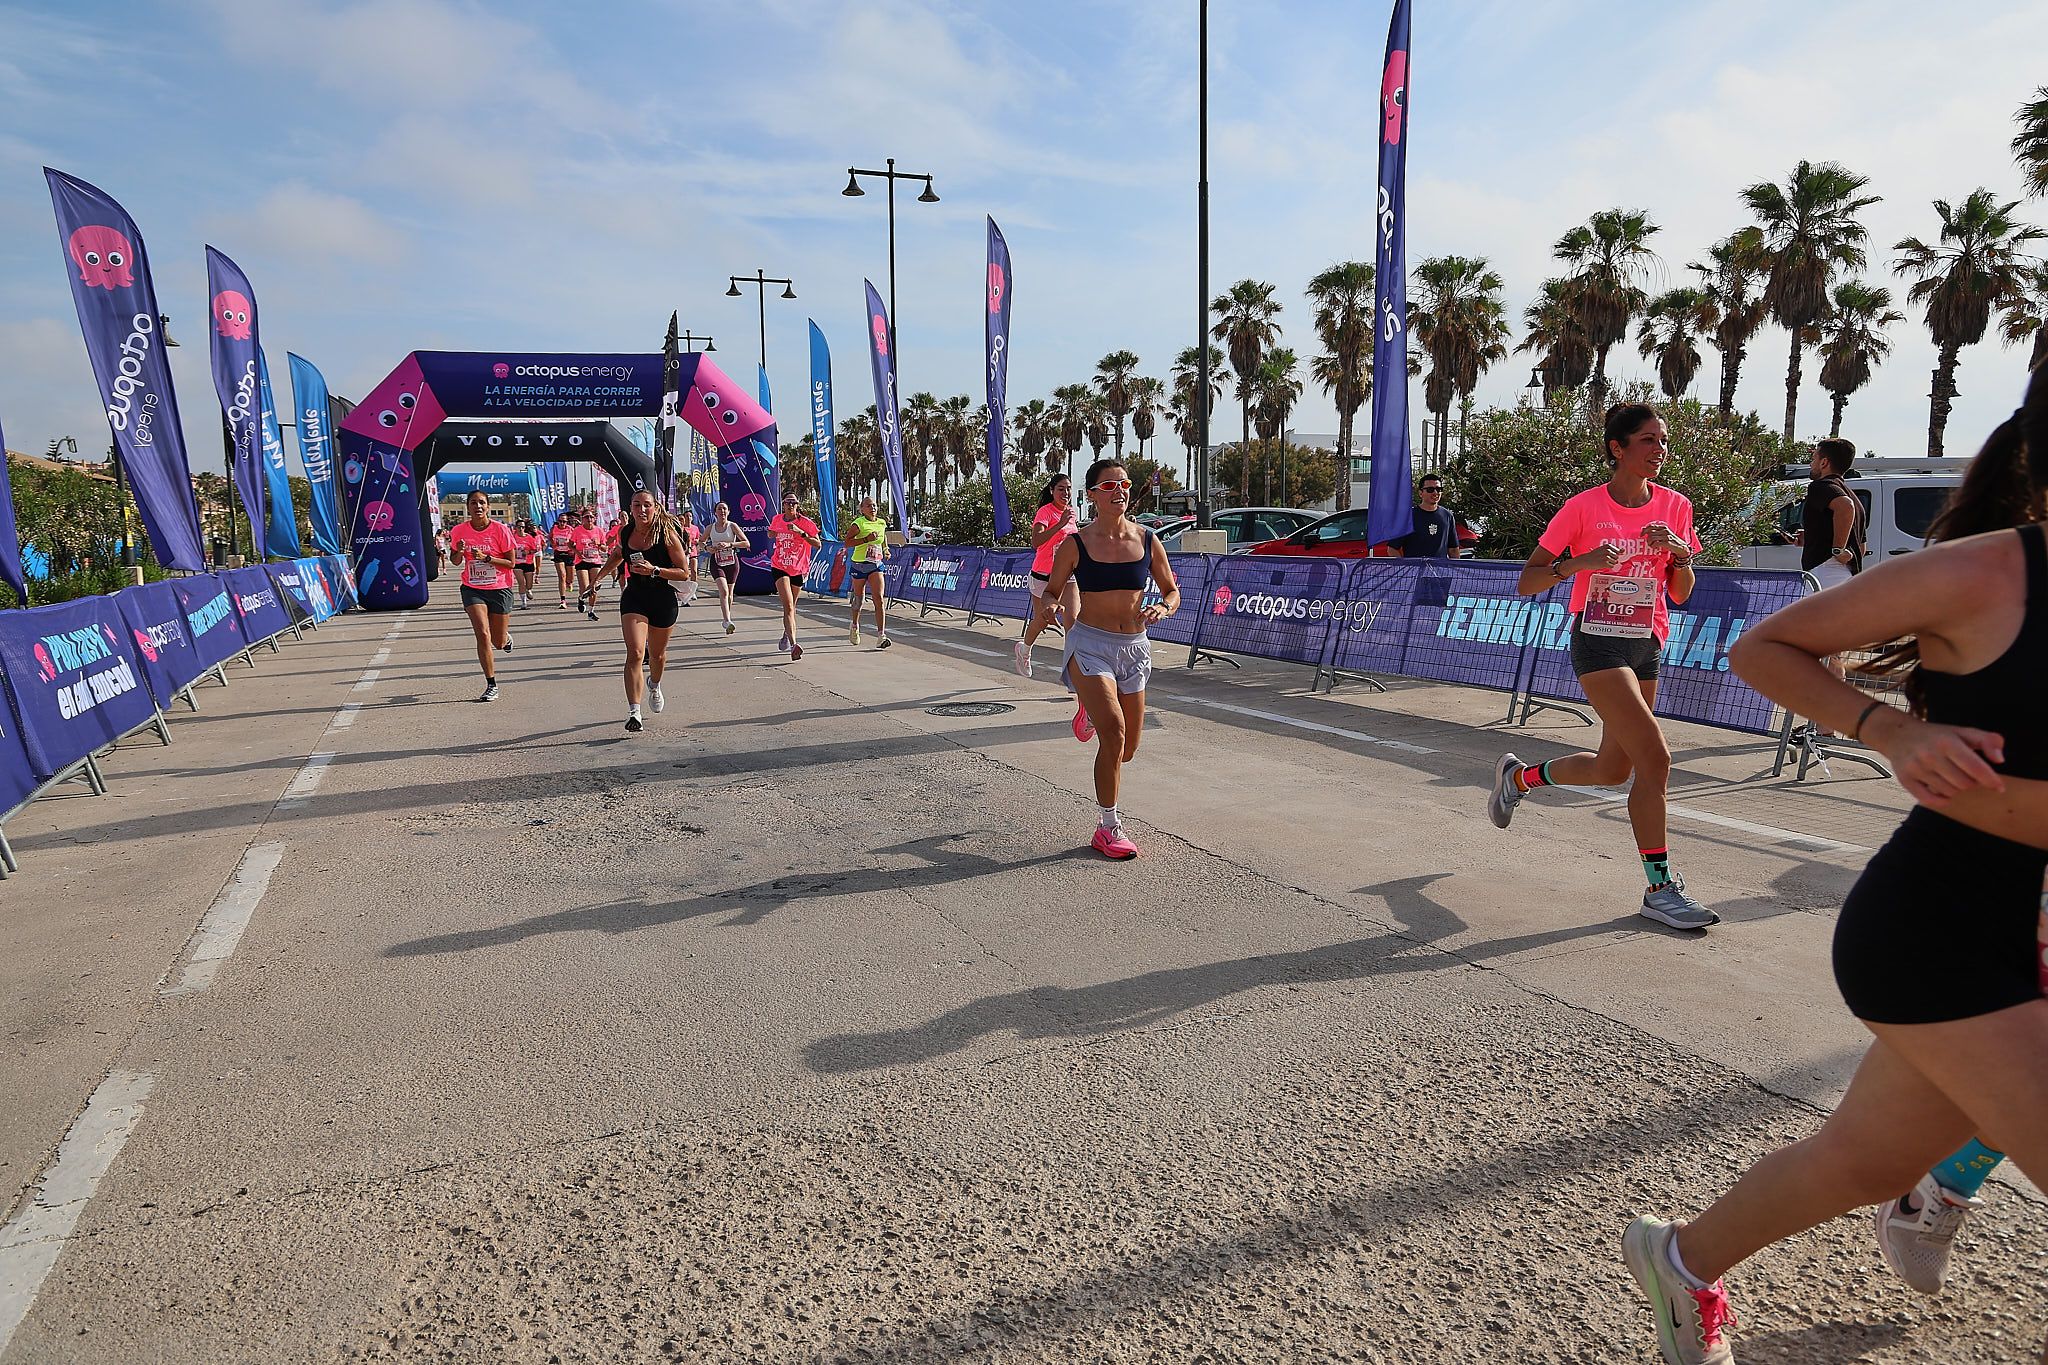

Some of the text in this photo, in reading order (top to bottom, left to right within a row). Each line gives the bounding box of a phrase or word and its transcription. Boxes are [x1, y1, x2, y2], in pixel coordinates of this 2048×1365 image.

[515, 364, 634, 382] octopus energy
[485, 384, 641, 396] LA ENERGÍA PARA CORRER
[484, 398, 643, 407] A LA VELOCIDAD DE LA LUZ
[457, 435, 583, 446] VOLVO
[467, 474, 509, 490] Marlene
[990, 571, 1022, 592] octopus
[1235, 591, 1382, 633] octopus energy
[1607, 603, 1635, 615] 016
